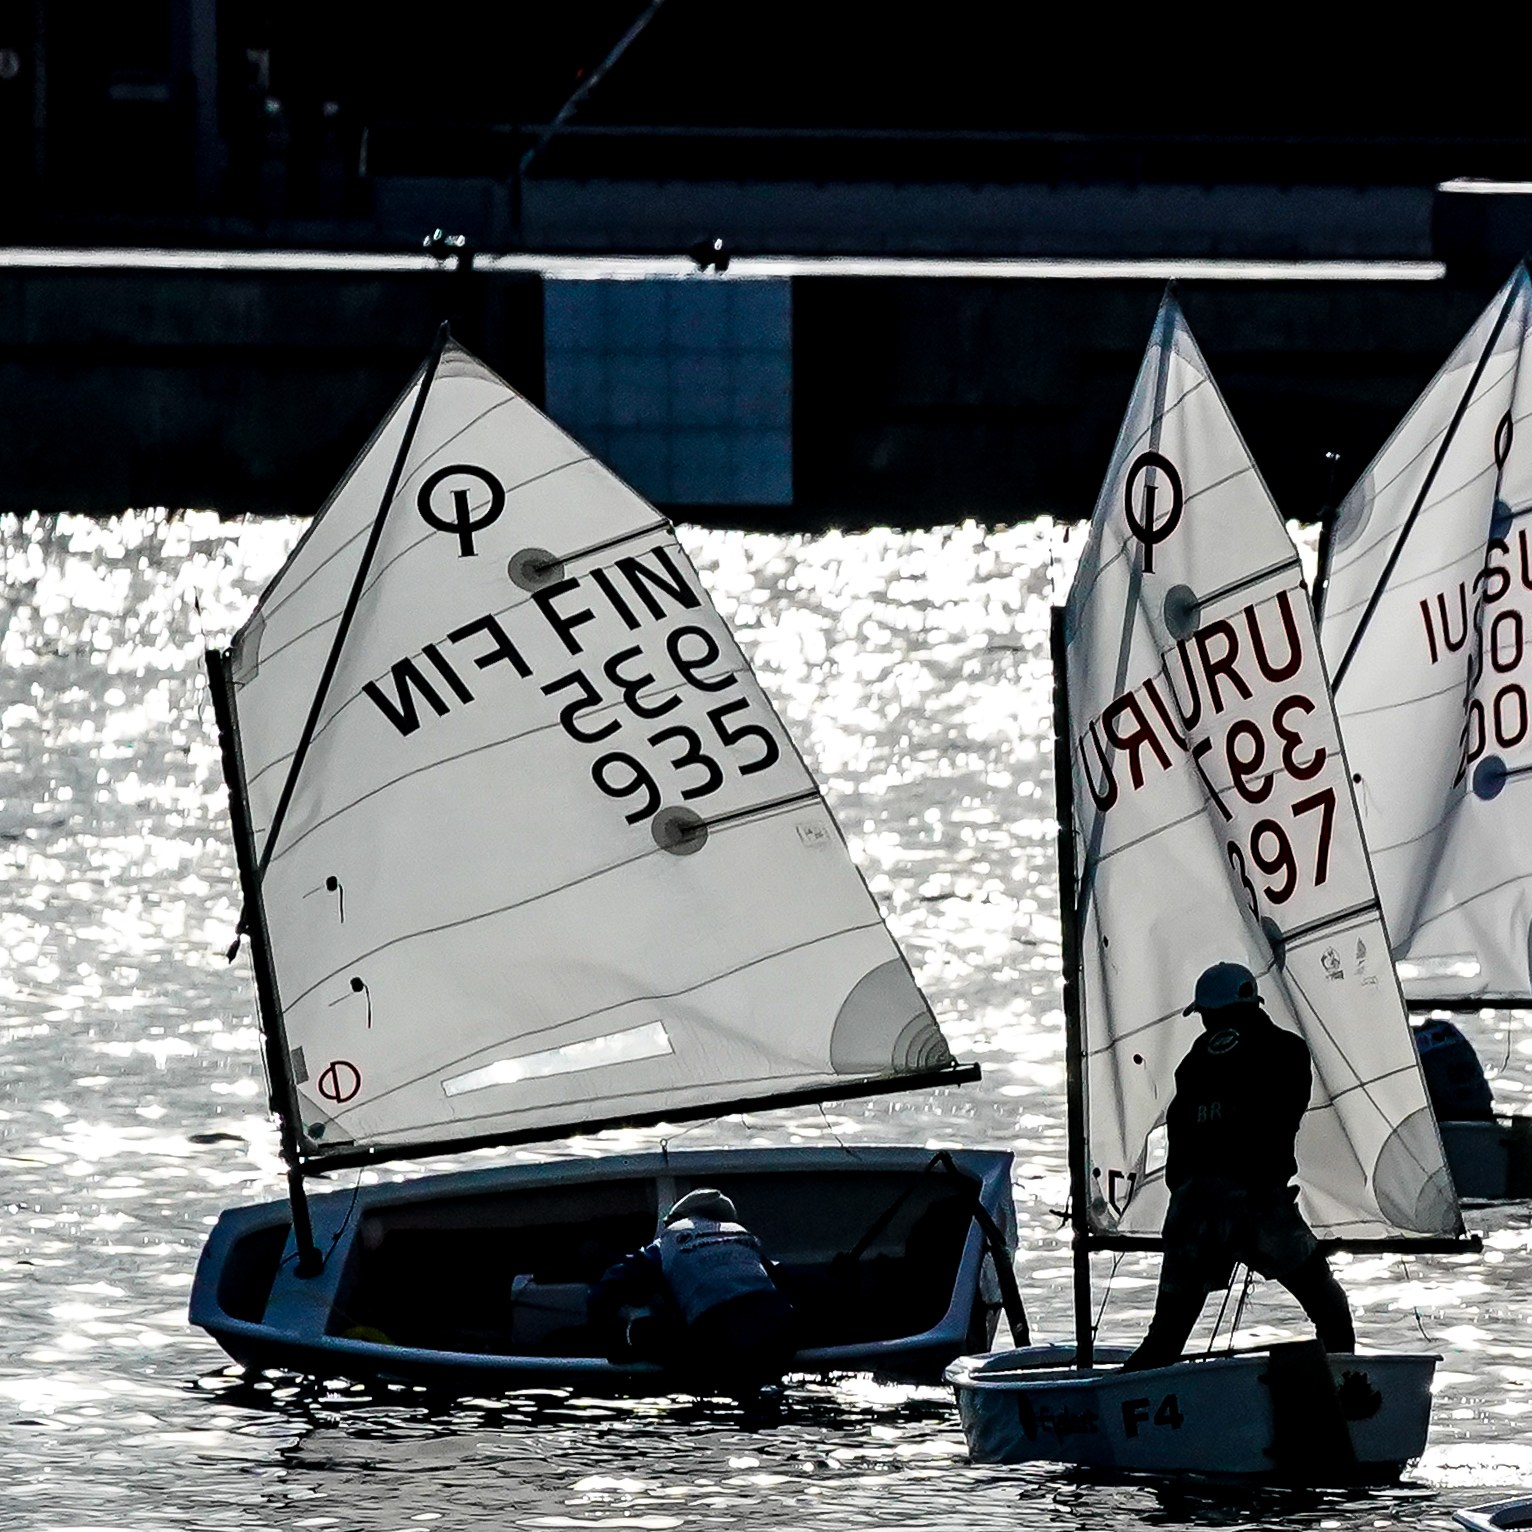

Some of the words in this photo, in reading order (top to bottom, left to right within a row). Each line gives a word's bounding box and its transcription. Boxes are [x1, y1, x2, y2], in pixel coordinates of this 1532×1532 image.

[529, 544, 703, 655] FIN
[1161, 589, 1303, 732] URU
[590, 698, 780, 827] 935
[1120, 1393, 1185, 1440] F4
